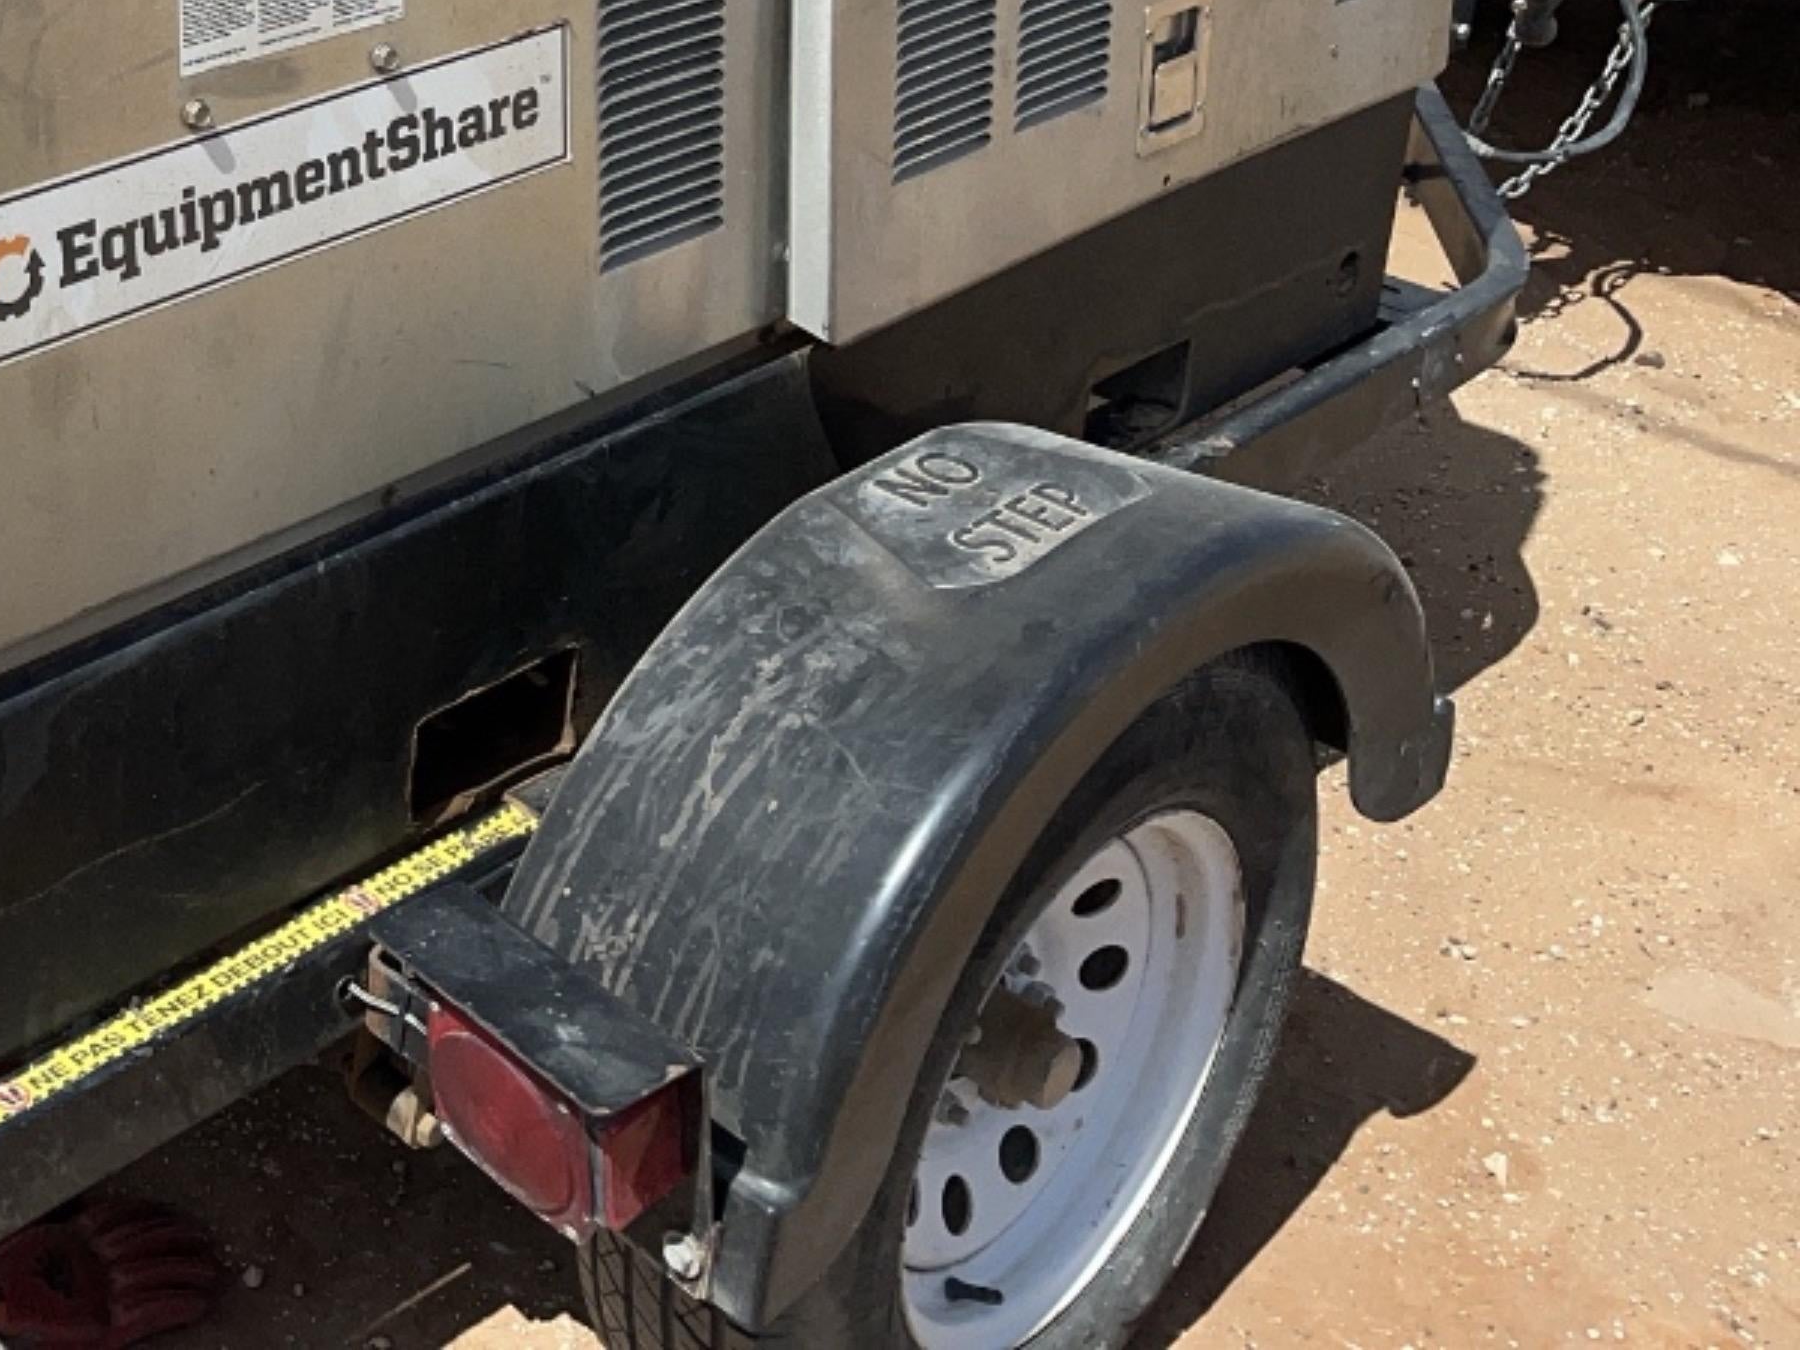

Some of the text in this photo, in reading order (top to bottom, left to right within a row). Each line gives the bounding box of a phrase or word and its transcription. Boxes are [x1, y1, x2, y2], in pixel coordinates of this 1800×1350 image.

[56, 86, 540, 288] EquipmentShare
[872, 451, 982, 508] NO
[950, 481, 1088, 563] STEP
[28, 1060, 70, 1090] NE
[67, 1031, 127, 1068] PAS
[122, 982, 214, 1034] TENEZ
[209, 928, 312, 989] DEBOUT
